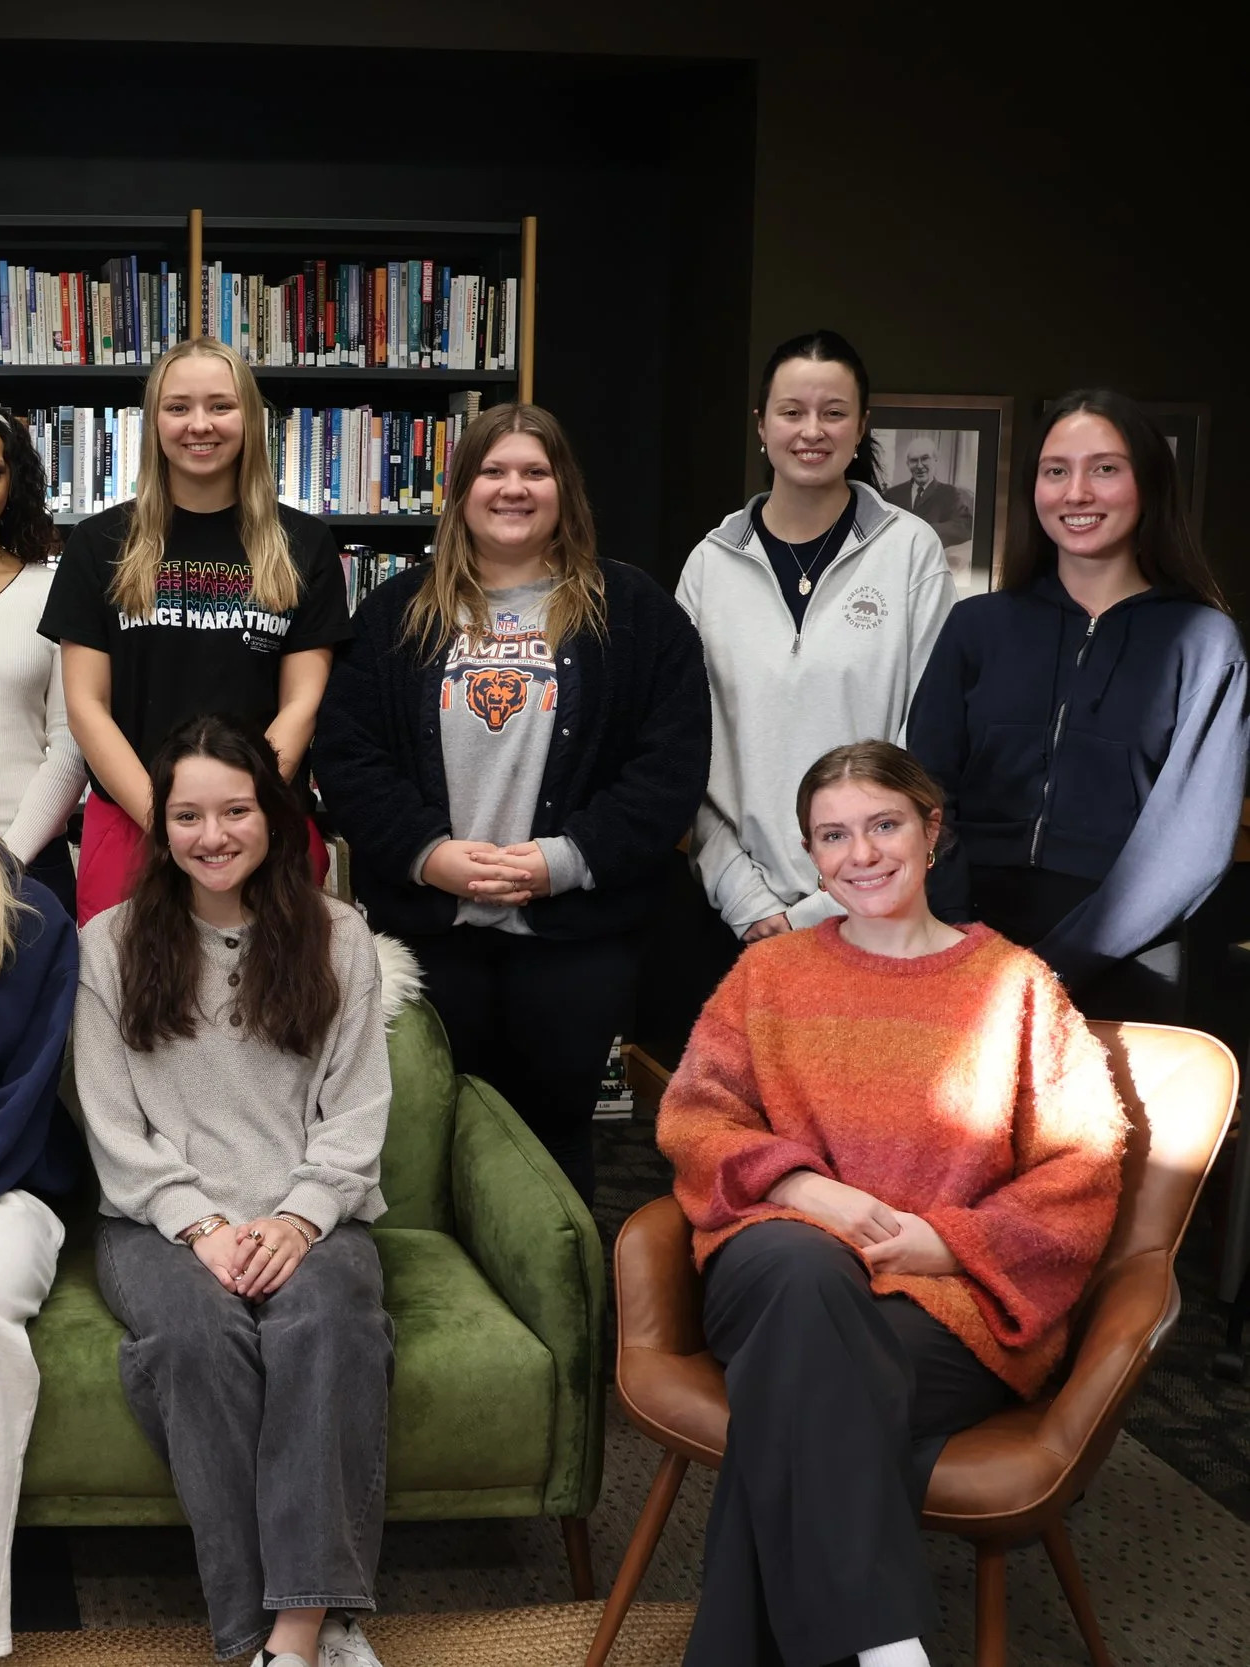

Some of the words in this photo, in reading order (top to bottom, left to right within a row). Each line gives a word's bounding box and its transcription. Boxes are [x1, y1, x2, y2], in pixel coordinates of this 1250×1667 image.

[305, 315, 315, 336] Magic
[847, 586, 870, 602] GREAT
[871, 587, 887, 608] FALLS
[118, 608, 182, 630] DANCE
[186, 610, 291, 637] MARATHON
[497, 621, 518, 631] NFL
[844, 613, 883, 630] MONTANA
